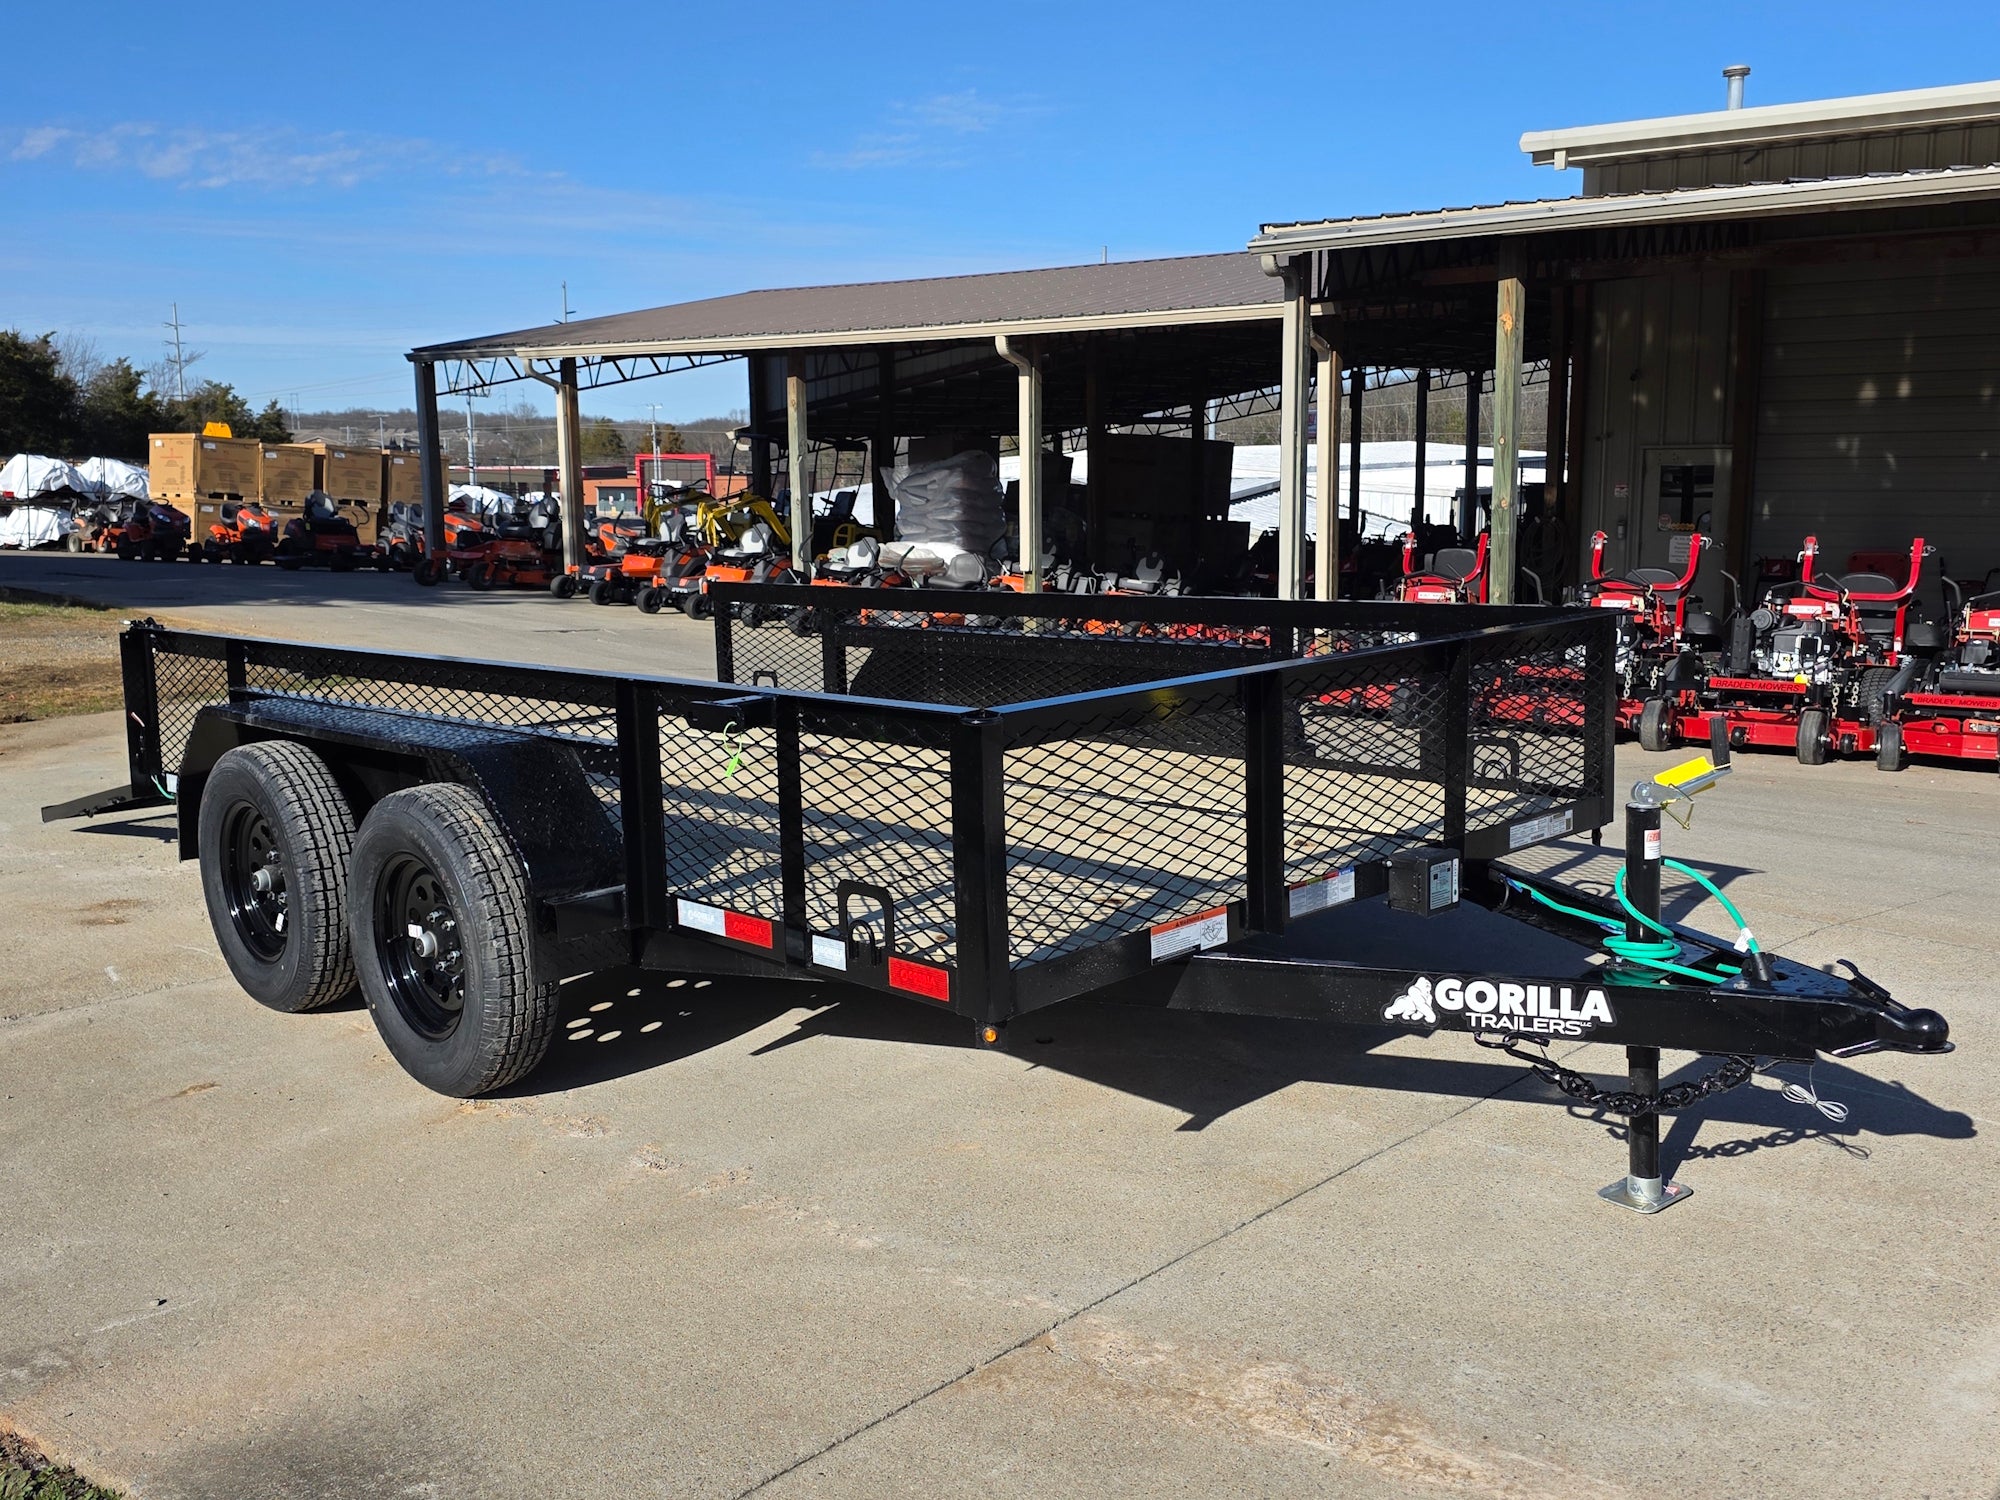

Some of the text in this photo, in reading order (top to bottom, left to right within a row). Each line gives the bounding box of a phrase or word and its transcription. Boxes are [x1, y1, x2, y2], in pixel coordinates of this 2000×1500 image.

[1716, 680, 1800, 692] BRADLEY MOWERS
[1916, 696, 1998, 708] BRADLEY MOWERS
[1435, 978, 1613, 1023] GORILLA
[1465, 1012, 1582, 1036] TRAILERS
